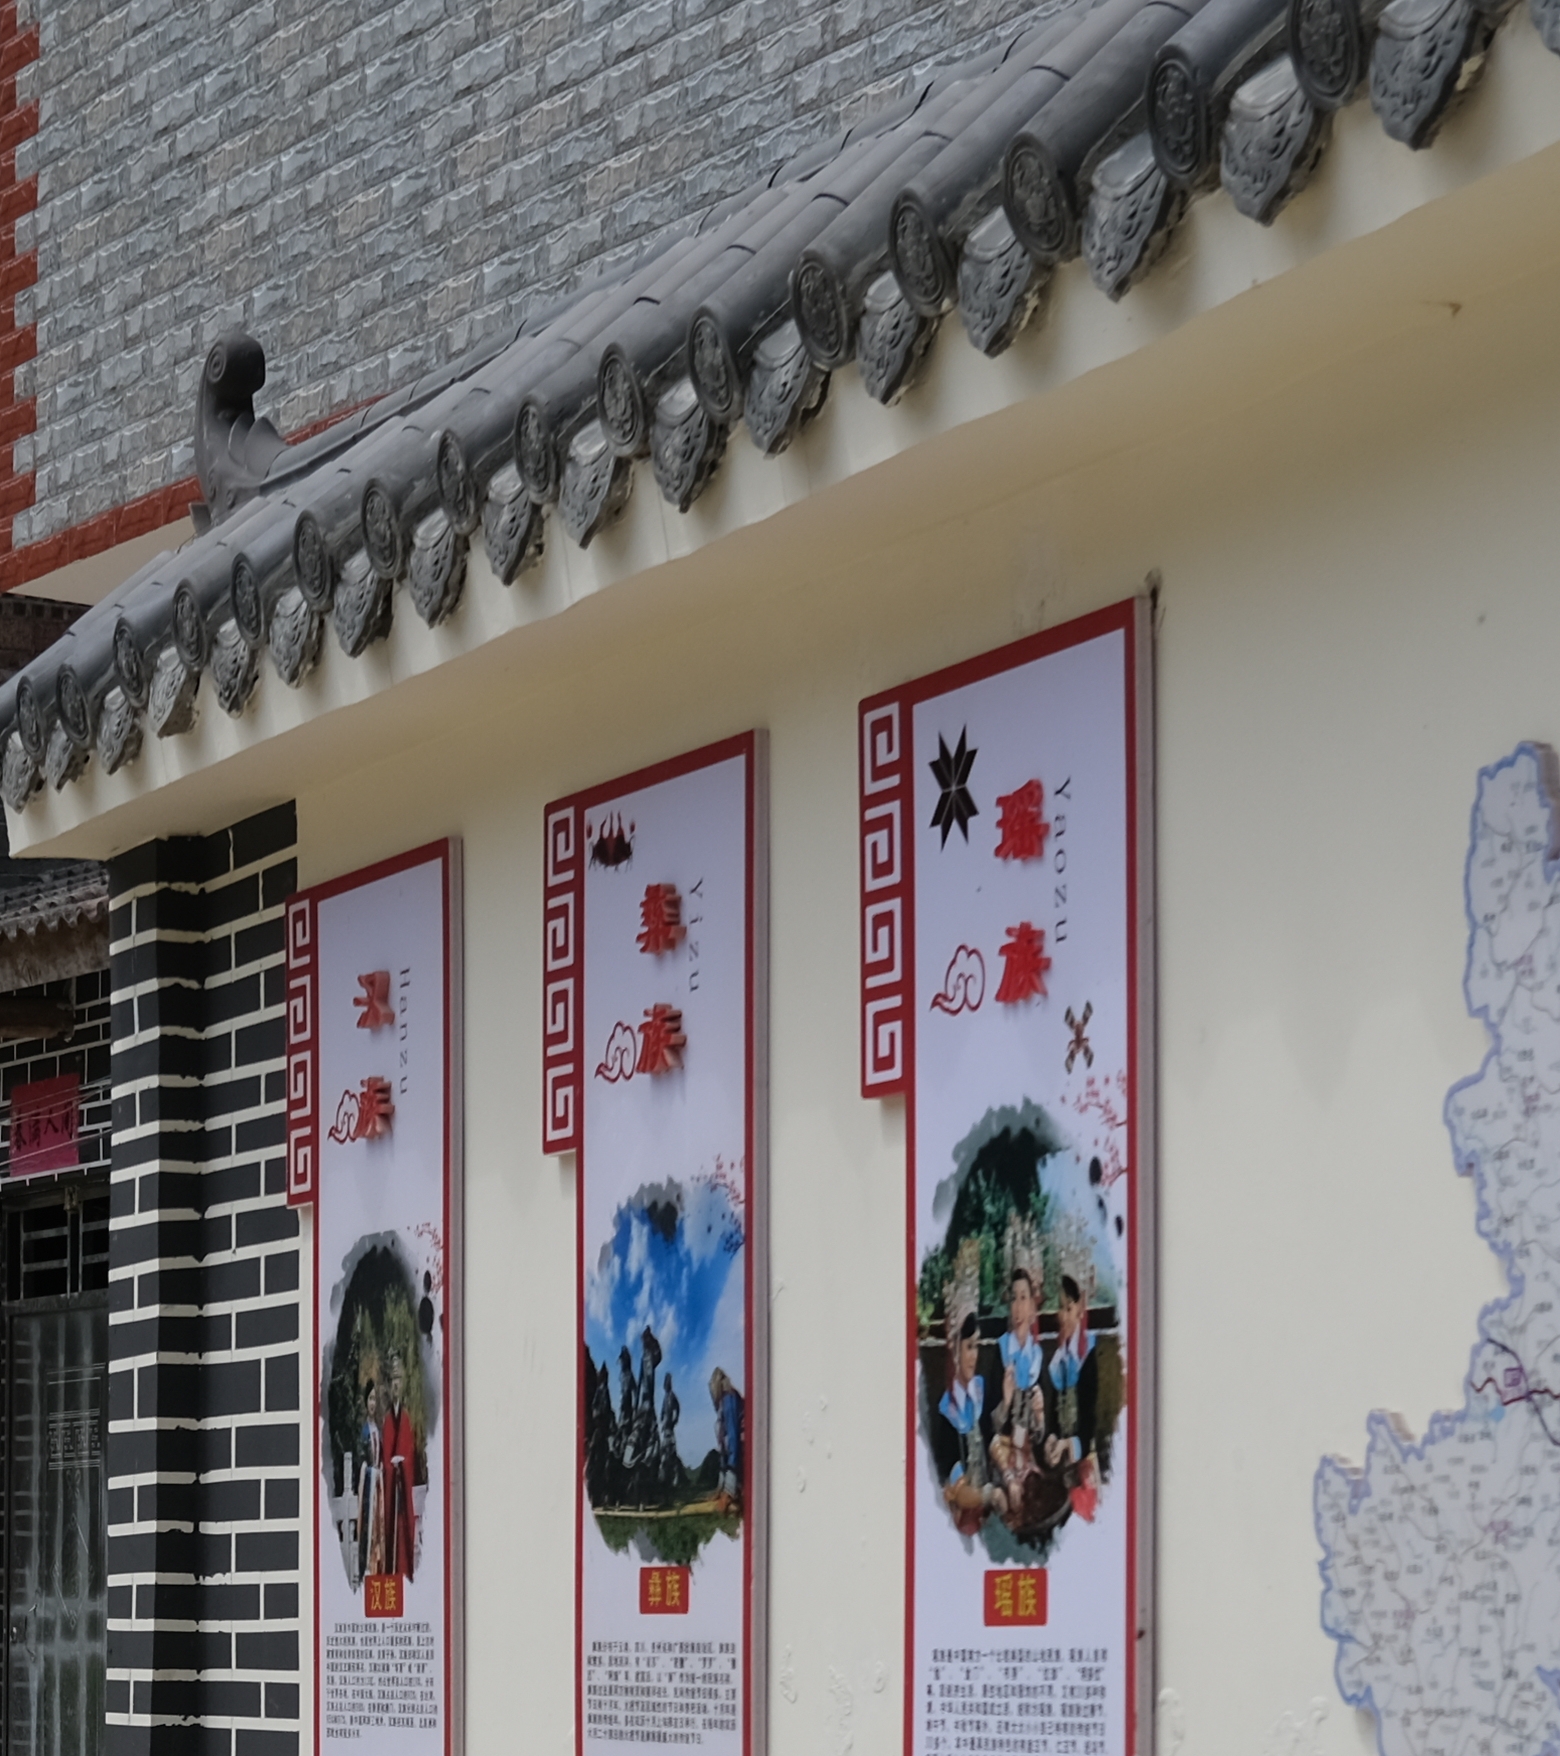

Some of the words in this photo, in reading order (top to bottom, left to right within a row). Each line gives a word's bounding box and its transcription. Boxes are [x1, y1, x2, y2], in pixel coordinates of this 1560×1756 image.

[994, 778, 1051, 1004] 瑶族
[1054, 776, 1071, 944] Yaozu
[690, 878, 703, 992] Yizu
[399, 967, 411, 1095] Hanzu
[370, 1578, 396, 1610] 汉族
[648, 1570, 680, 1606] 彝族
[994, 1573, 1037, 1617] 瑶族
